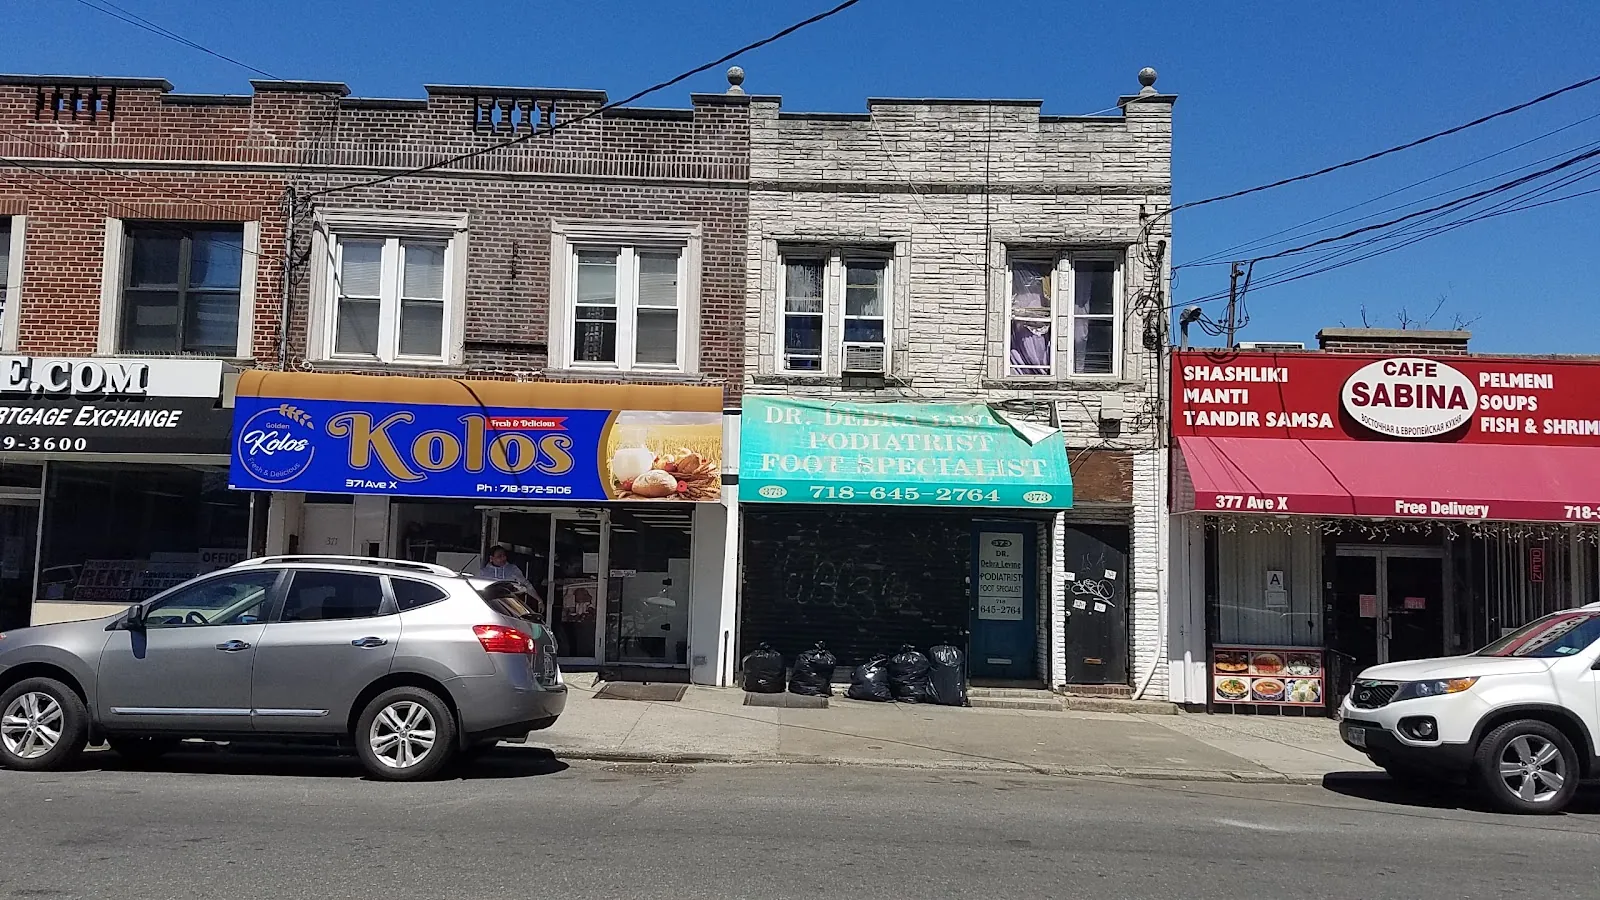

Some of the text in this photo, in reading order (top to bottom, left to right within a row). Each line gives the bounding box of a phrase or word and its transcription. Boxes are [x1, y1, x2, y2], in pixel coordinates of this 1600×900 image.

[0, 357, 149, 395] E.COM
[1183, 366, 1288, 382] SHASHLIKI
[1383, 361, 1437, 377] CAFE
[1479, 372, 1553, 389] PELMENI
[1183, 388, 1248, 404] MANTI
[1351, 381, 1469, 410] SABINA
[1480, 395, 1538, 411] SOUPS
[73, 406, 183, 427] EXCHANGE
[764, 405, 814, 425] DR.
[1183, 411, 1334, 428] TANDIR SAMSA
[265, 422, 290, 430] Golden
[491, 419, 556, 429] Fresh & Delicious
[1361, 413, 1395, 434] ВОСТОЧНАЯ
[1401, 422, 1444, 435] ЕВРОПЕЙСКАЯ
[1445, 414, 1462, 430] КУХНЯ
[1480, 417, 1600, 436] FISH & SHRIM
[3, 436, 87, 450] 9-3600
[243, 430, 309, 455] Kolos
[325, 410, 575, 481] Kolos
[808, 431, 993, 452] PODIATRIST
[247, 457, 263, 474] Fresh
[270, 462, 300, 478] Delicious
[760, 453, 1047, 478] FOOT SPECIALIST
[345, 479, 398, 490] 371 Ave X
[476, 483, 492, 493] Ph
[499, 484, 572, 494] 718-372-5106
[761, 487, 784, 497] 373
[809, 484, 1000, 501] 718-645-2764
[1027, 493, 1049, 502] 373
[1215, 495, 1288, 510] 377 Ave X
[1395, 500, 1489, 518] Free Delivery
[202, 552, 245, 563] OFFICE
[981, 560, 999, 568] Debra
[980, 572, 1022, 581] PODIATRIST
[1270, 573, 1280, 585] A
[980, 584, 1021, 593] FOOT SPECIALIST
[980, 605, 1021, 614] 645-2764
